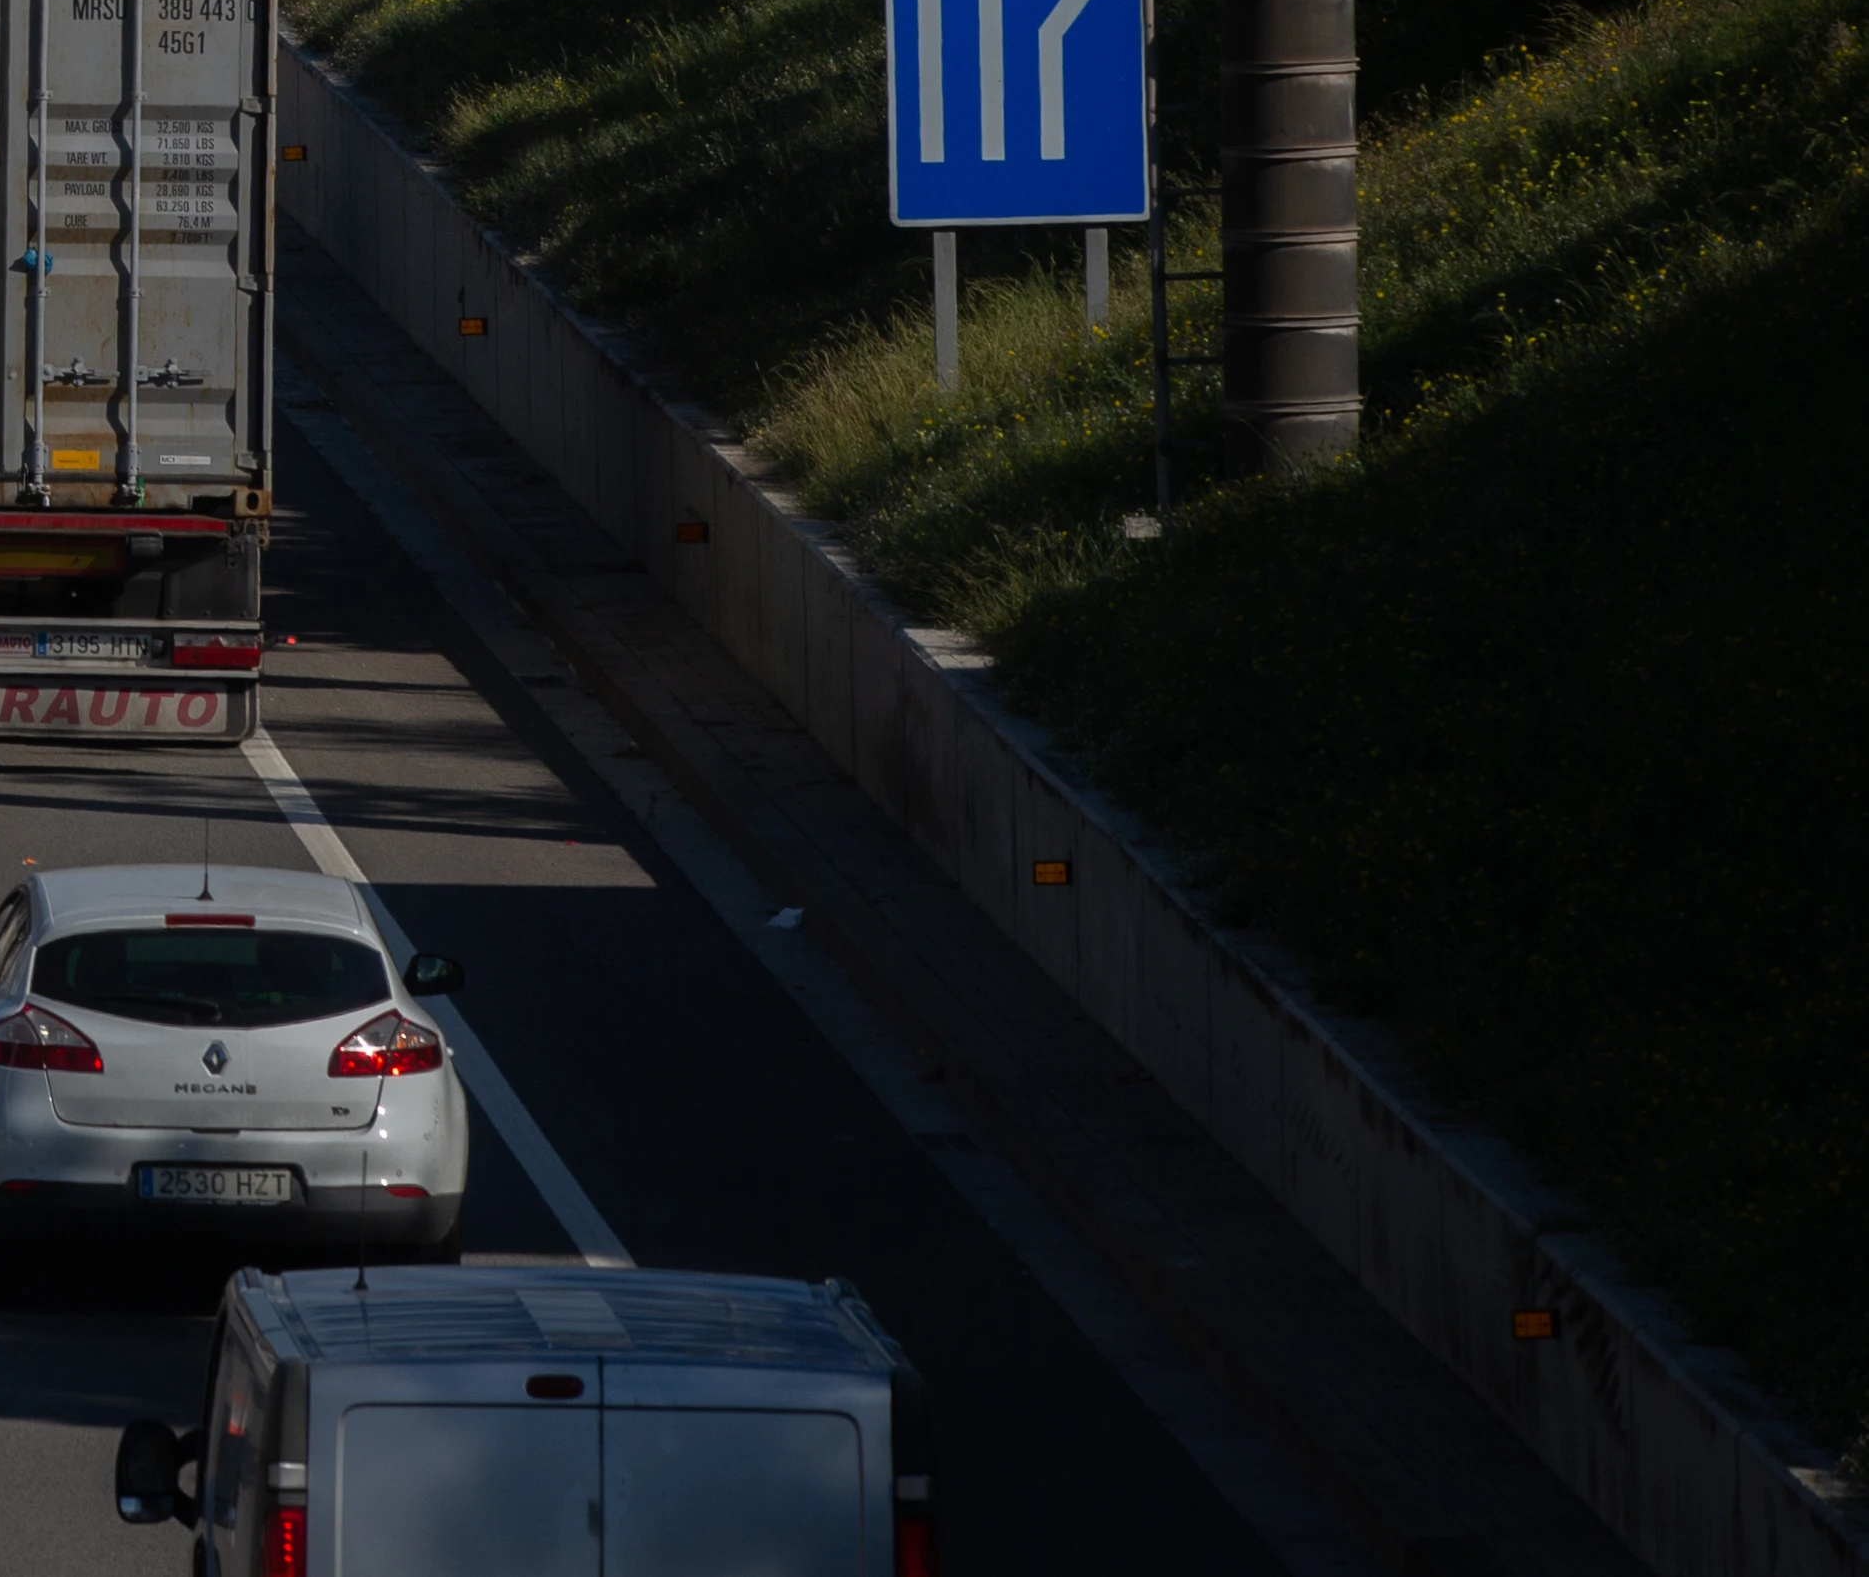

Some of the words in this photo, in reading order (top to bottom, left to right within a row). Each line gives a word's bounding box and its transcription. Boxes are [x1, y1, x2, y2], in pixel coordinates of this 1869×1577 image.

[157, 31, 206, 55] 45G1
[93, 120, 122, 134] GROSS
[197, 121, 214, 134] KGS
[196, 138, 215, 150] LBS
[66, 152, 88, 165] TARE
[196, 154, 215, 166] KGS
[196, 169, 214, 182] LBS
[64, 183, 105, 196] PAYLOAD
[196, 185, 214, 197] KGS
[196, 201, 214, 213] LBS
[64, 215, 88, 228] CUBE
[53, 635, 100, 655] 3195
[111, 634, 150, 655] HTN
[159, 1171, 226, 1195] 2530
[236, 1172, 286, 1196] HZT
